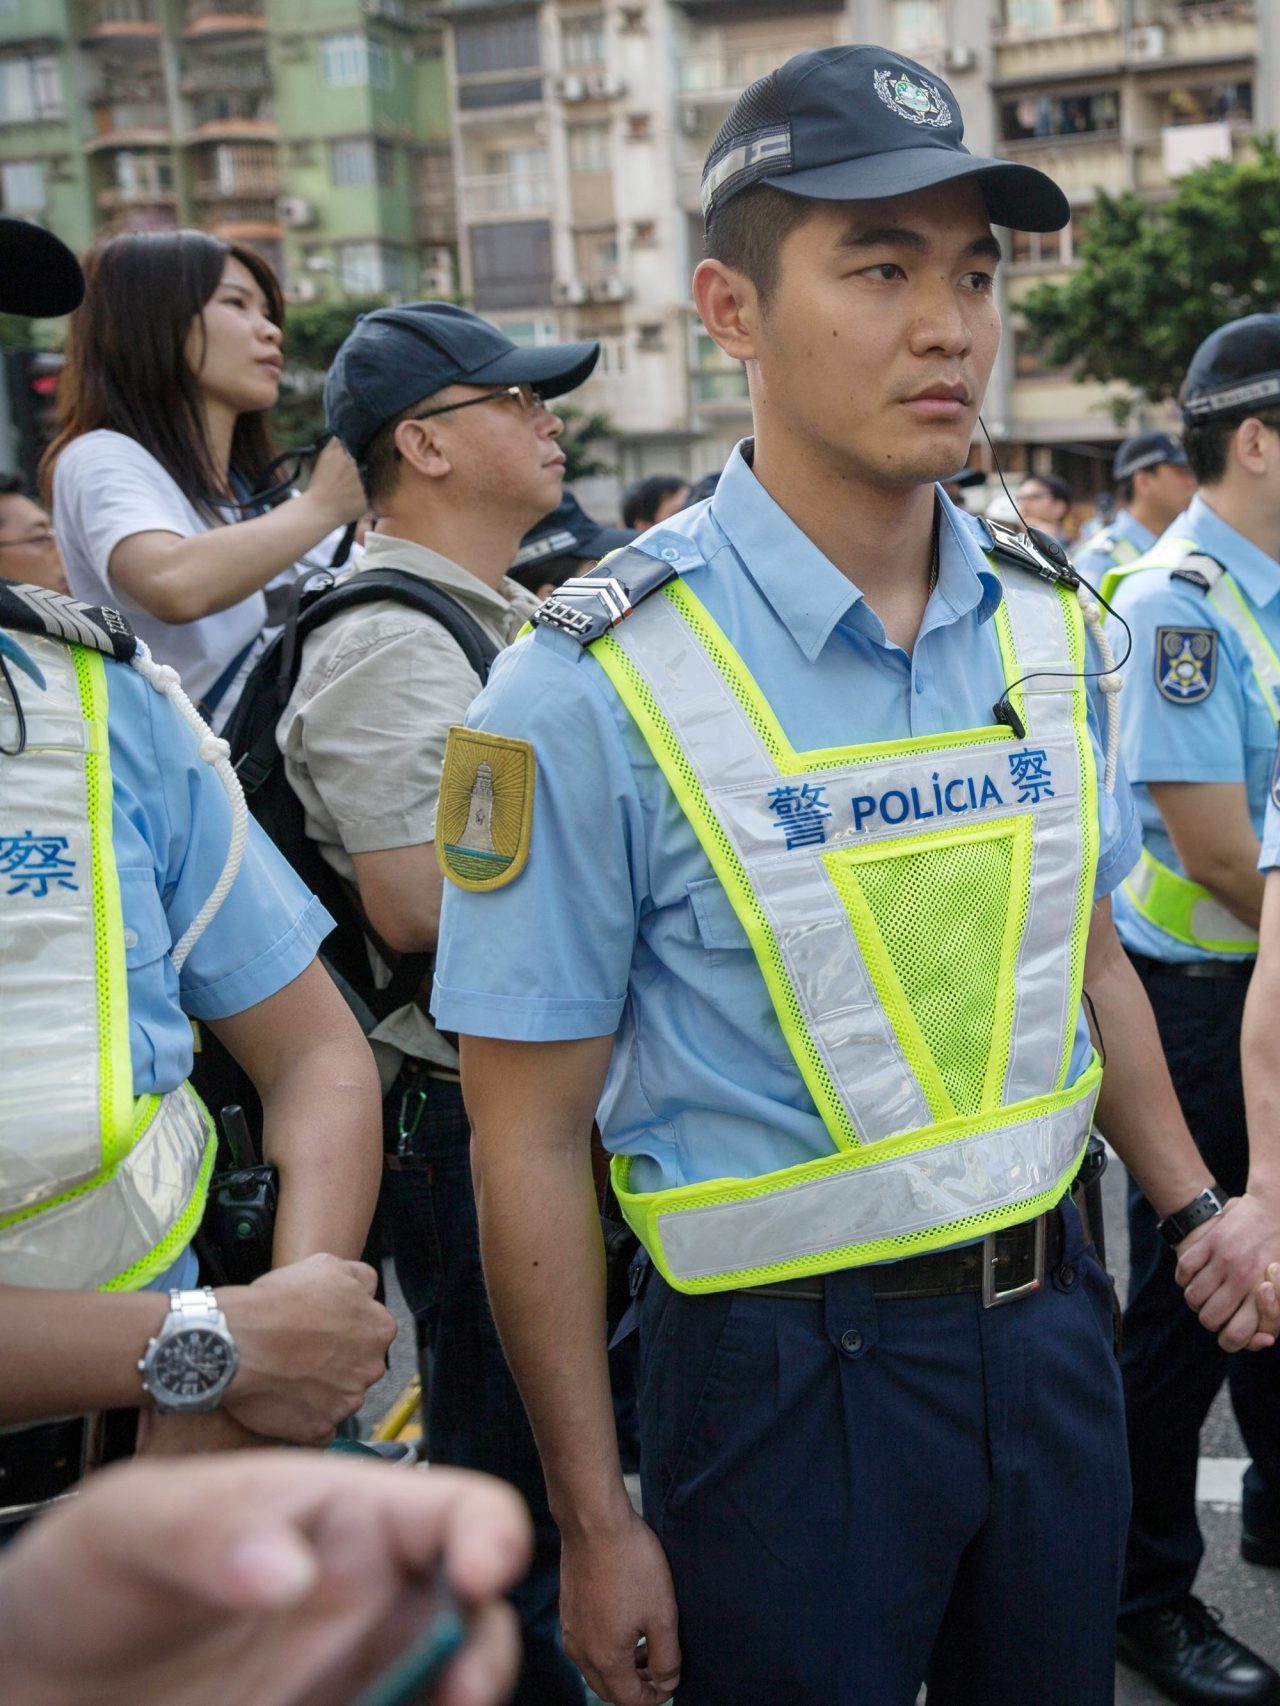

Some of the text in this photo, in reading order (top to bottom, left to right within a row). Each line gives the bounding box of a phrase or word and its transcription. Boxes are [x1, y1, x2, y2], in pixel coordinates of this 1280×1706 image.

[767, 747, 1055, 851] 警 POLÍCIA 察
[0, 829, 79, 898] 察
